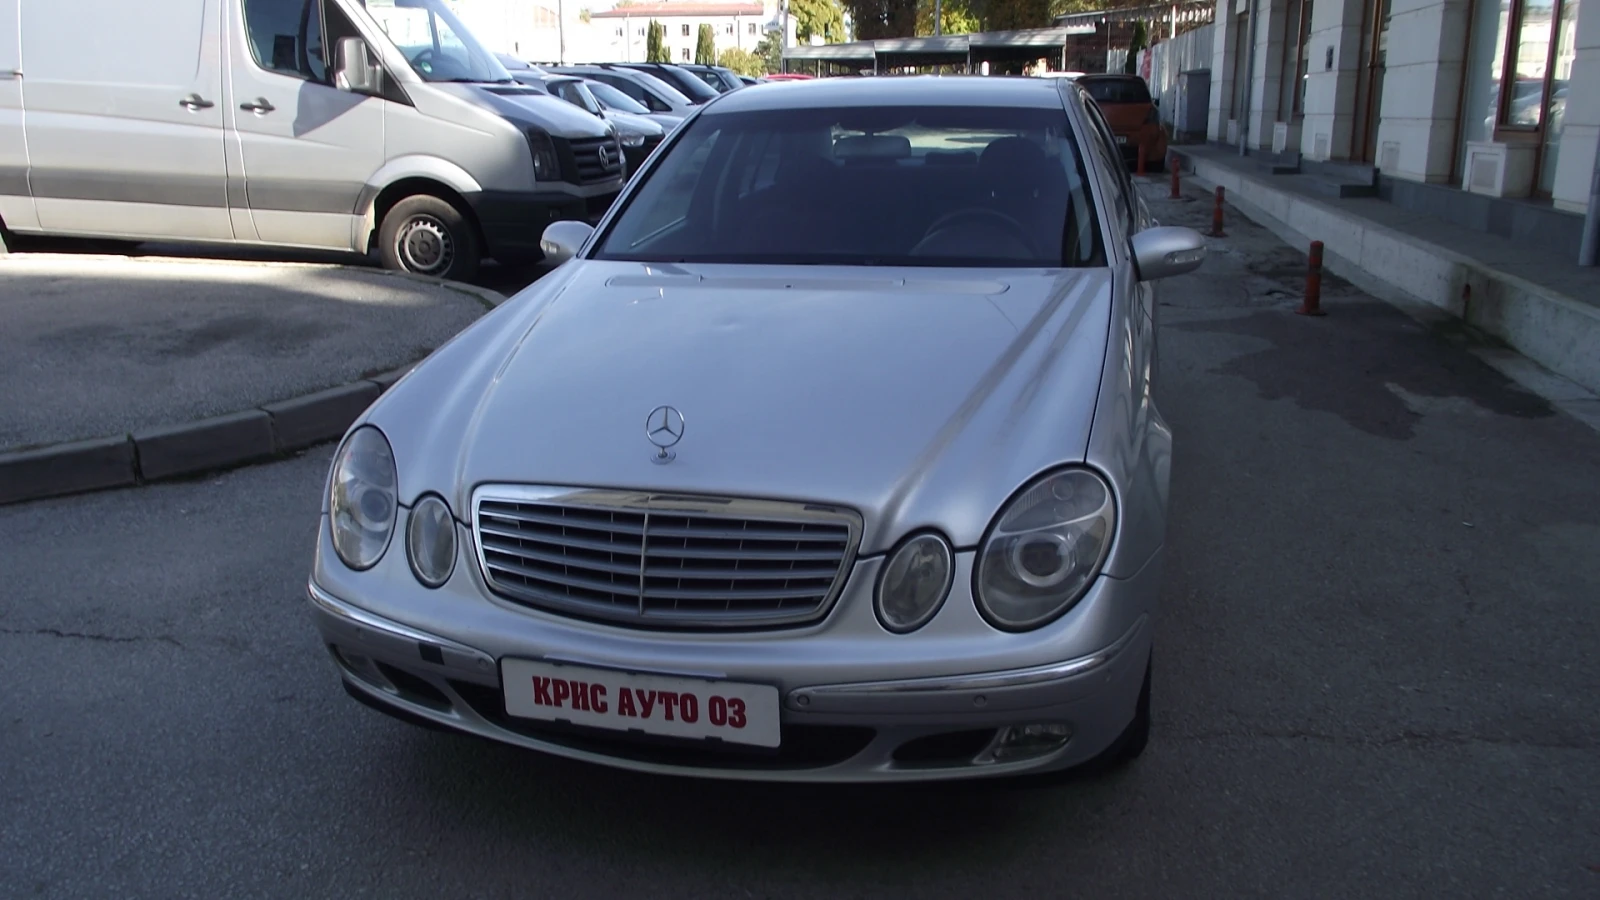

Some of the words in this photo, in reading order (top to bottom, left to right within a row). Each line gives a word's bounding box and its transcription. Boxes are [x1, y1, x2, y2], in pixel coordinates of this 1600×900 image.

[532, 676, 608, 714] КРИС
[618, 687, 699, 724] АУТО
[709, 696, 747, 729] 03
